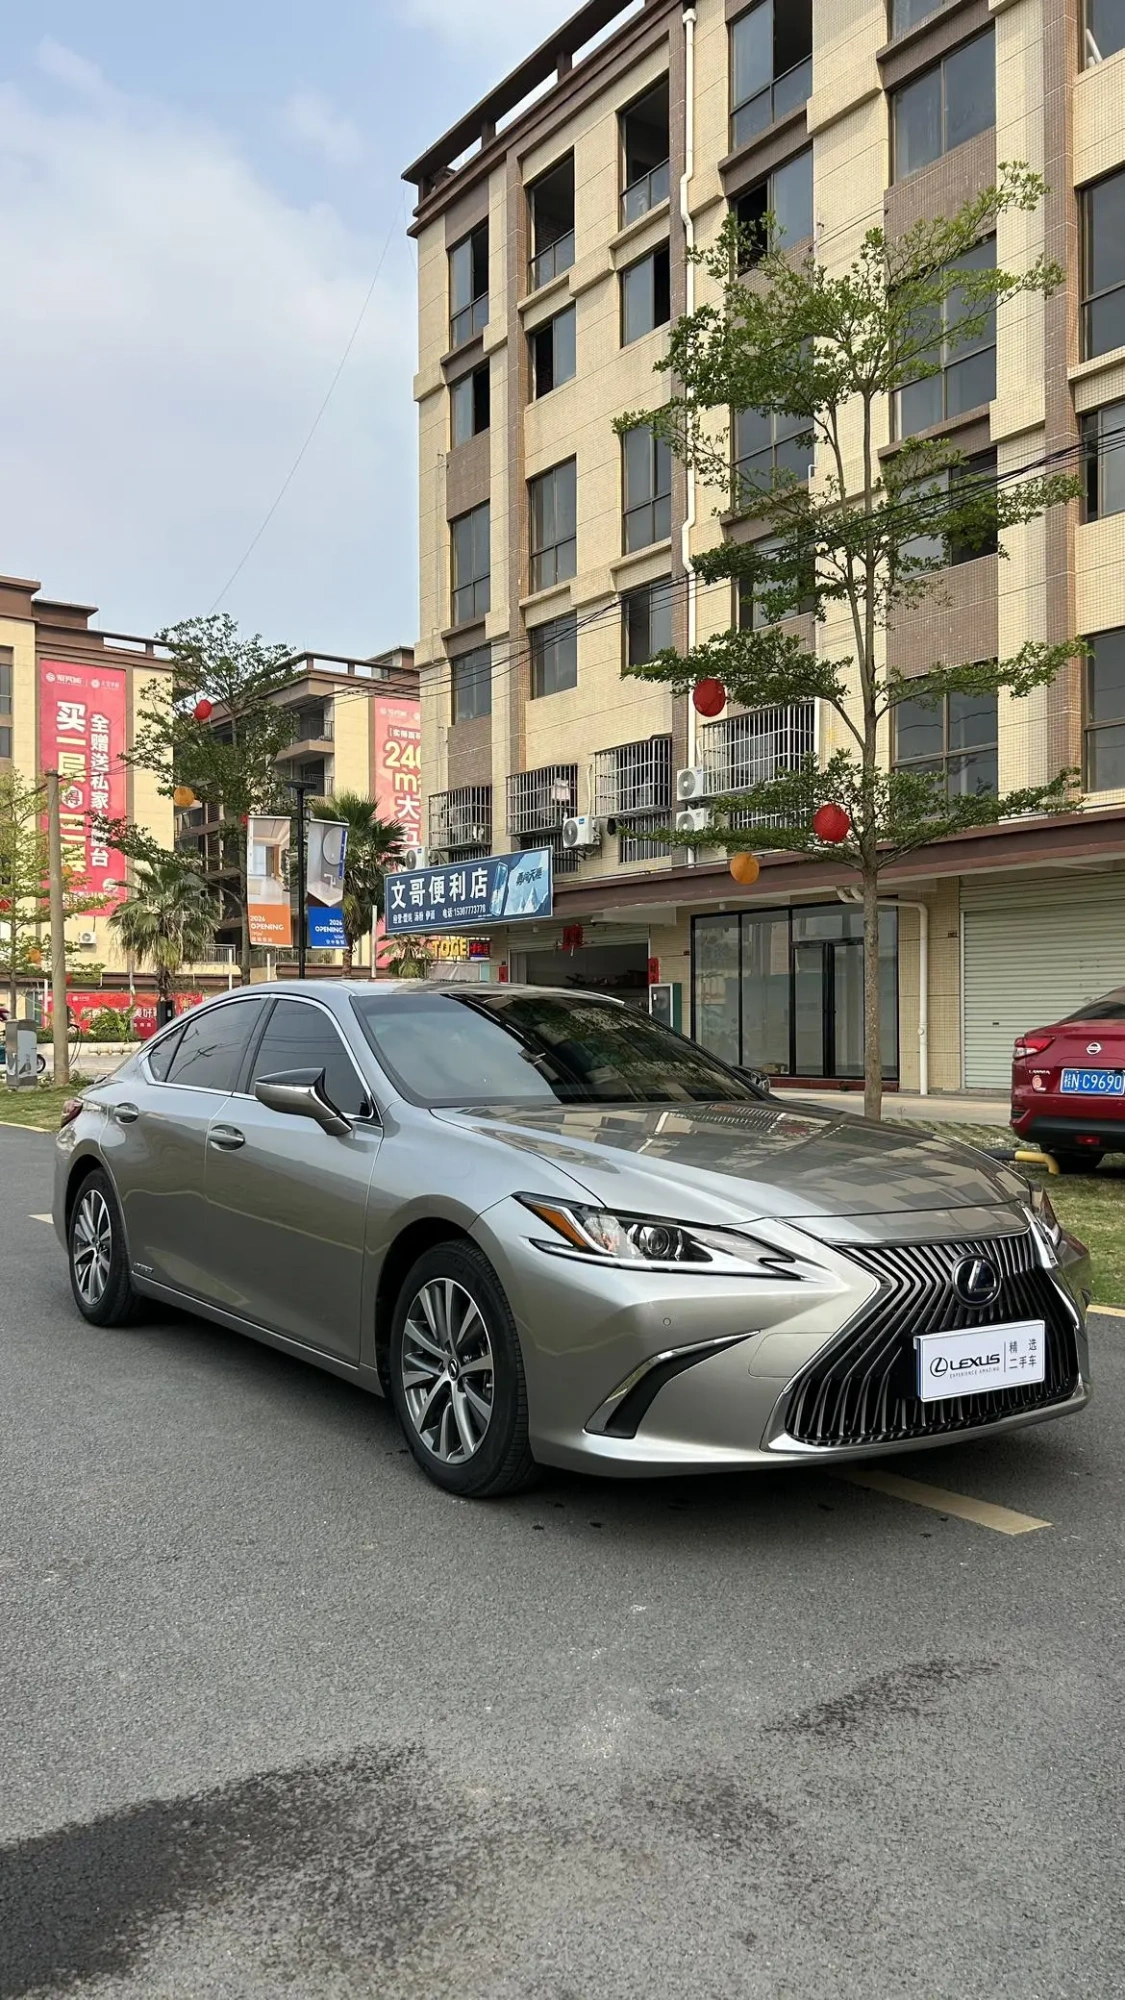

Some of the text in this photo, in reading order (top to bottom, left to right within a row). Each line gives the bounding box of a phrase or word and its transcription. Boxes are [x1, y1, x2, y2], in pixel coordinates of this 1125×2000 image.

[390, 866, 489, 910] 文哥便利店
[250, 922, 284, 931] OPENING
[314, 925, 344, 934] OPENING
[949, 1353, 1001, 1371] LEXUS
[1009, 1355, 1037, 1370] 二手车
